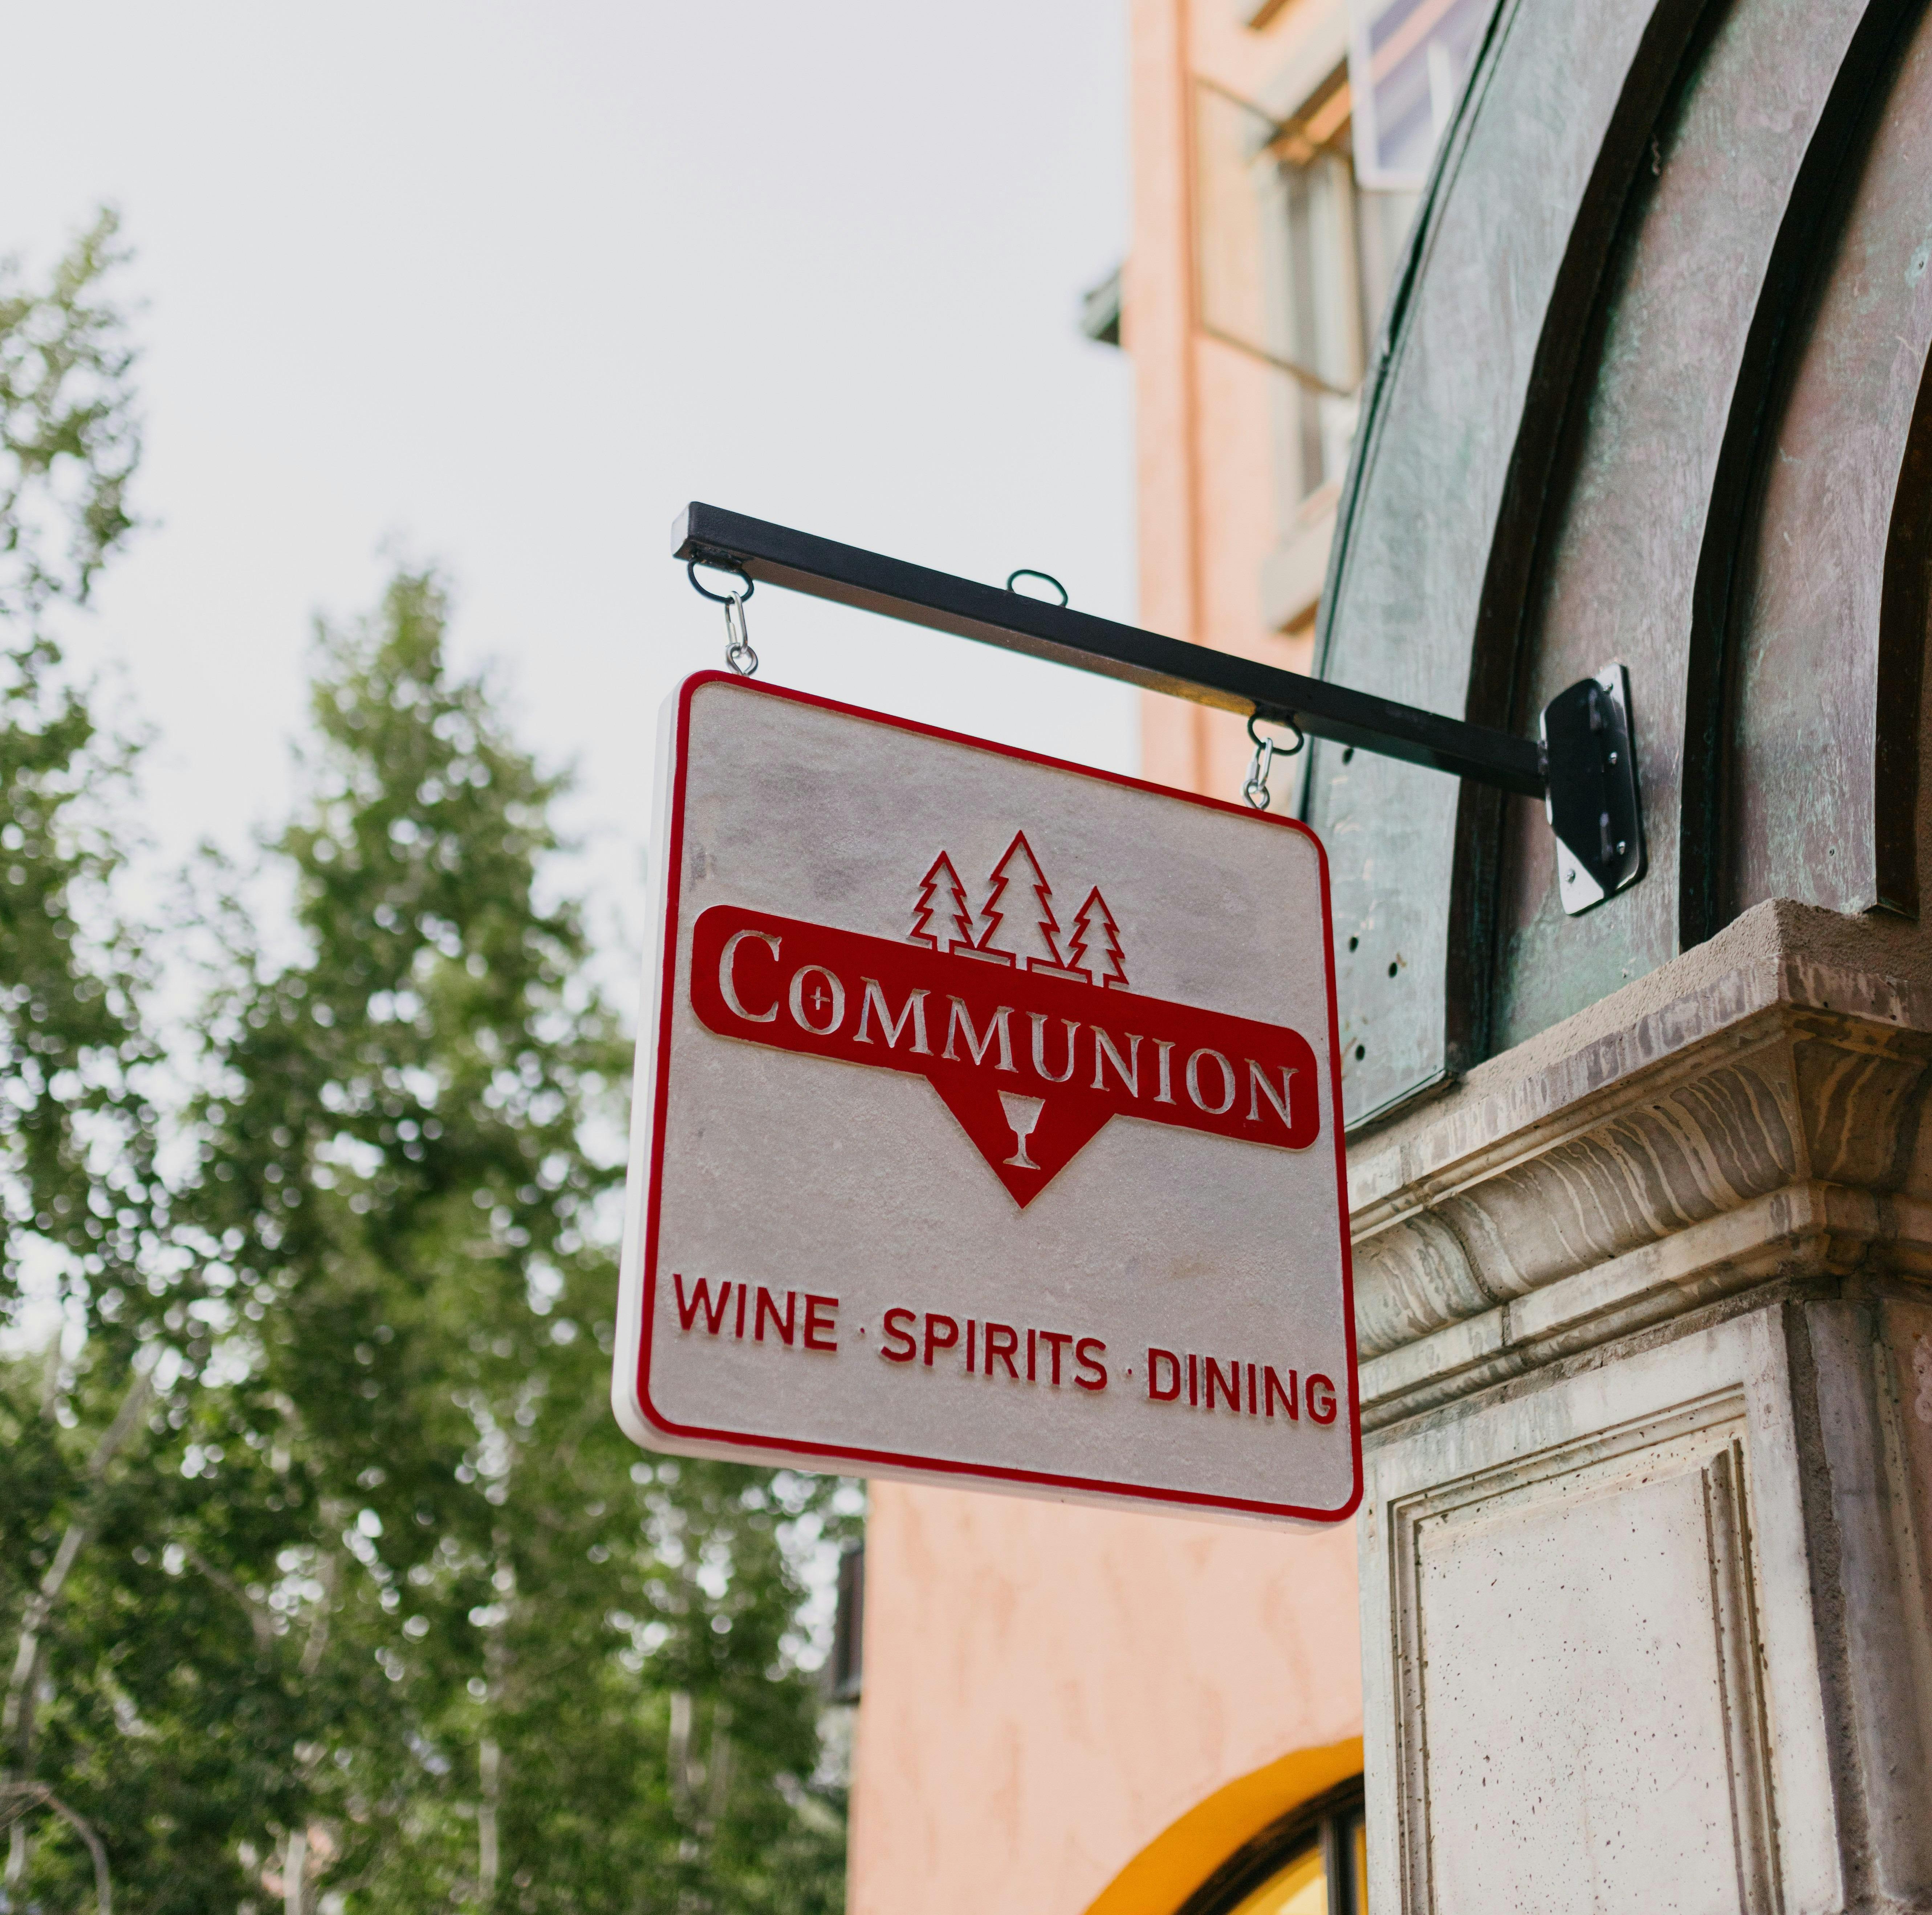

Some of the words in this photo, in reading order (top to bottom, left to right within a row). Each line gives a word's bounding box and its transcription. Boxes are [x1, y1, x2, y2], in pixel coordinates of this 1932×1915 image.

[719, 929, 1299, 1129] COMMUNION
[673, 1273, 839, 1352] WINE
[880, 1307, 1108, 1391] SPIRITS
[1148, 1348, 1337, 1425] DINING
